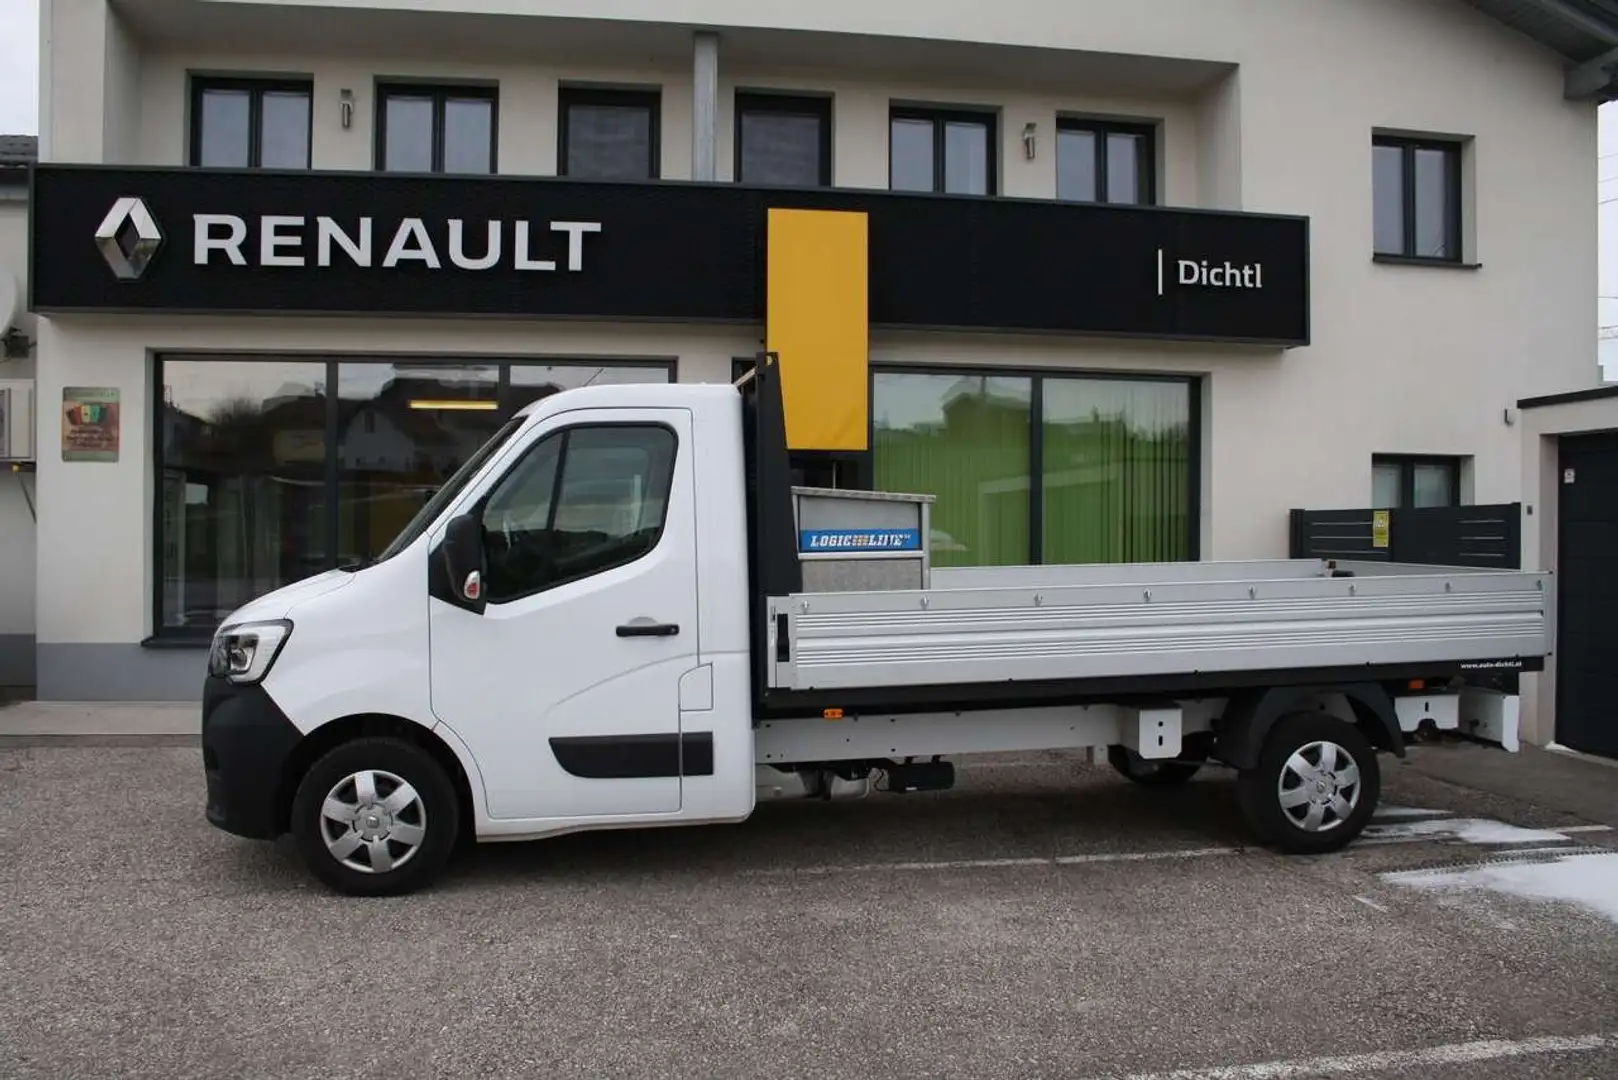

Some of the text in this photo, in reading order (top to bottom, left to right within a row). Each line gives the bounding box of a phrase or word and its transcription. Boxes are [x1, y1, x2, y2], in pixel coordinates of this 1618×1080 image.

[193, 213, 602, 272] RENAULT
[1177, 259, 1263, 289] Dichtl
[810, 534, 852, 547] LOGIC
